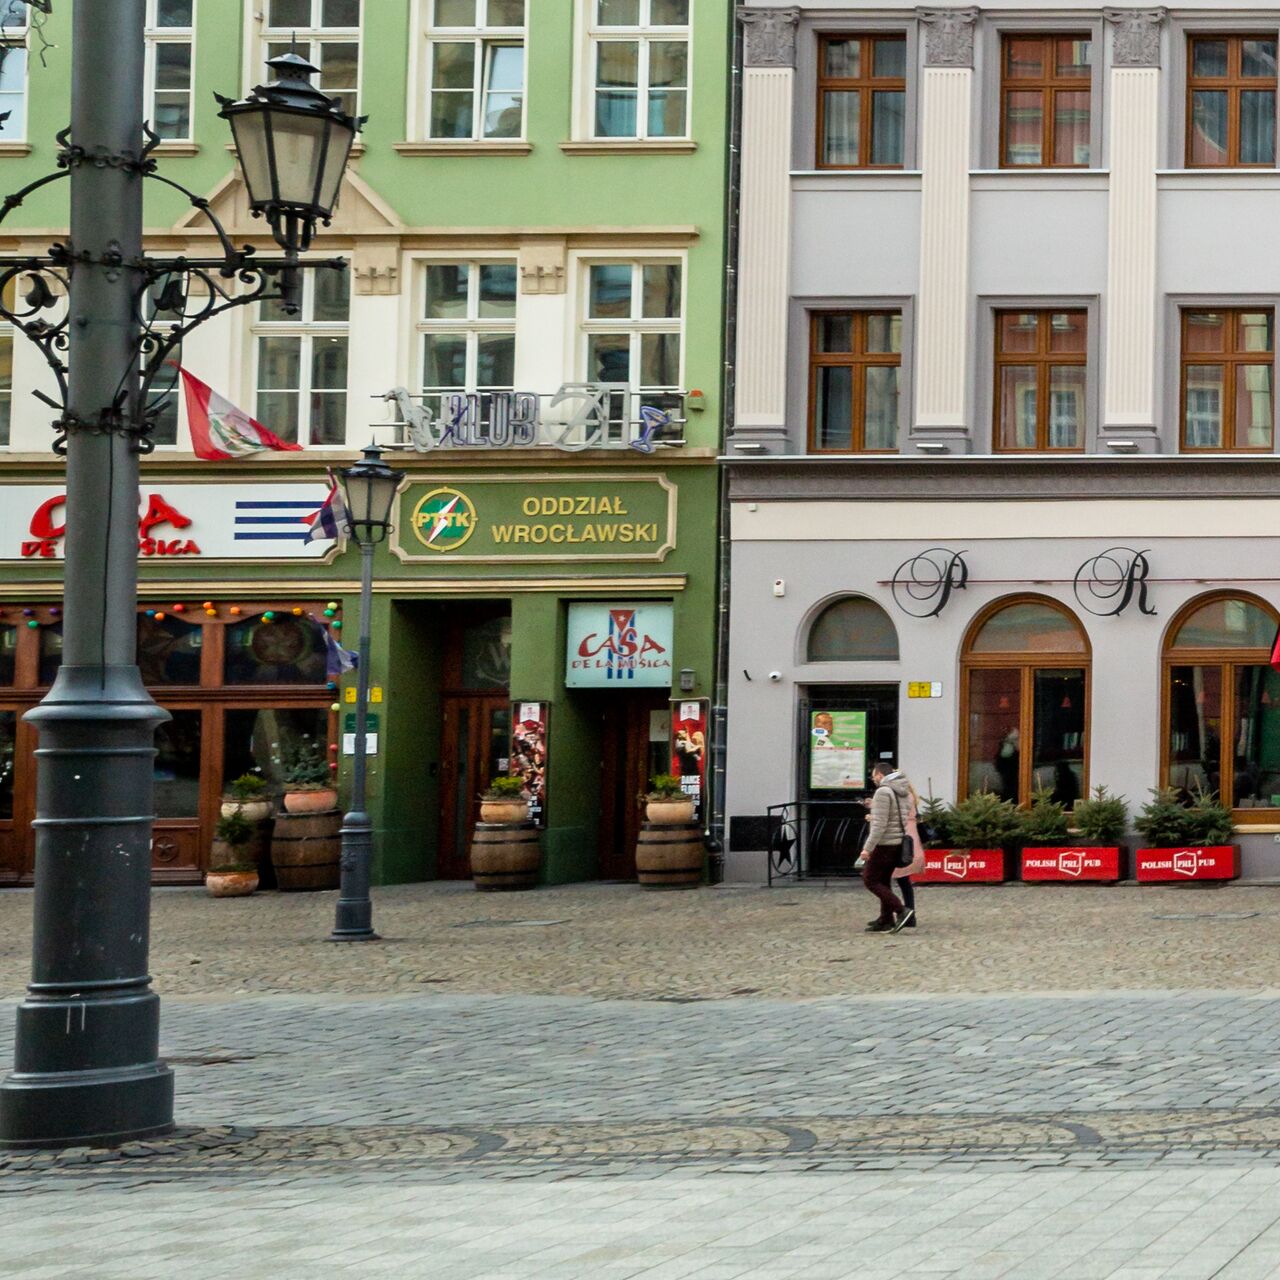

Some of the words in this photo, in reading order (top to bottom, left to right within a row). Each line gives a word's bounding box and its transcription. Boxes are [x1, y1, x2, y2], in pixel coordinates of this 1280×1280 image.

[522, 495, 629, 516] ODDZIAŁ
[30, 494, 192, 540] CA
[417, 512, 470, 528] PTTK
[491, 523, 658, 543] WROCŁAWSKI
[138, 539, 200, 556] SICA
[578, 627, 666, 658] CASA
[571, 660, 591, 669] DE
[595, 660, 613, 669] LA
[1062, 860, 1079, 868] PRL
[1141, 861, 1172, 869] POLISH
[1177, 859, 1193, 868] PRL
[1199, 858, 1215, 866] PUB
